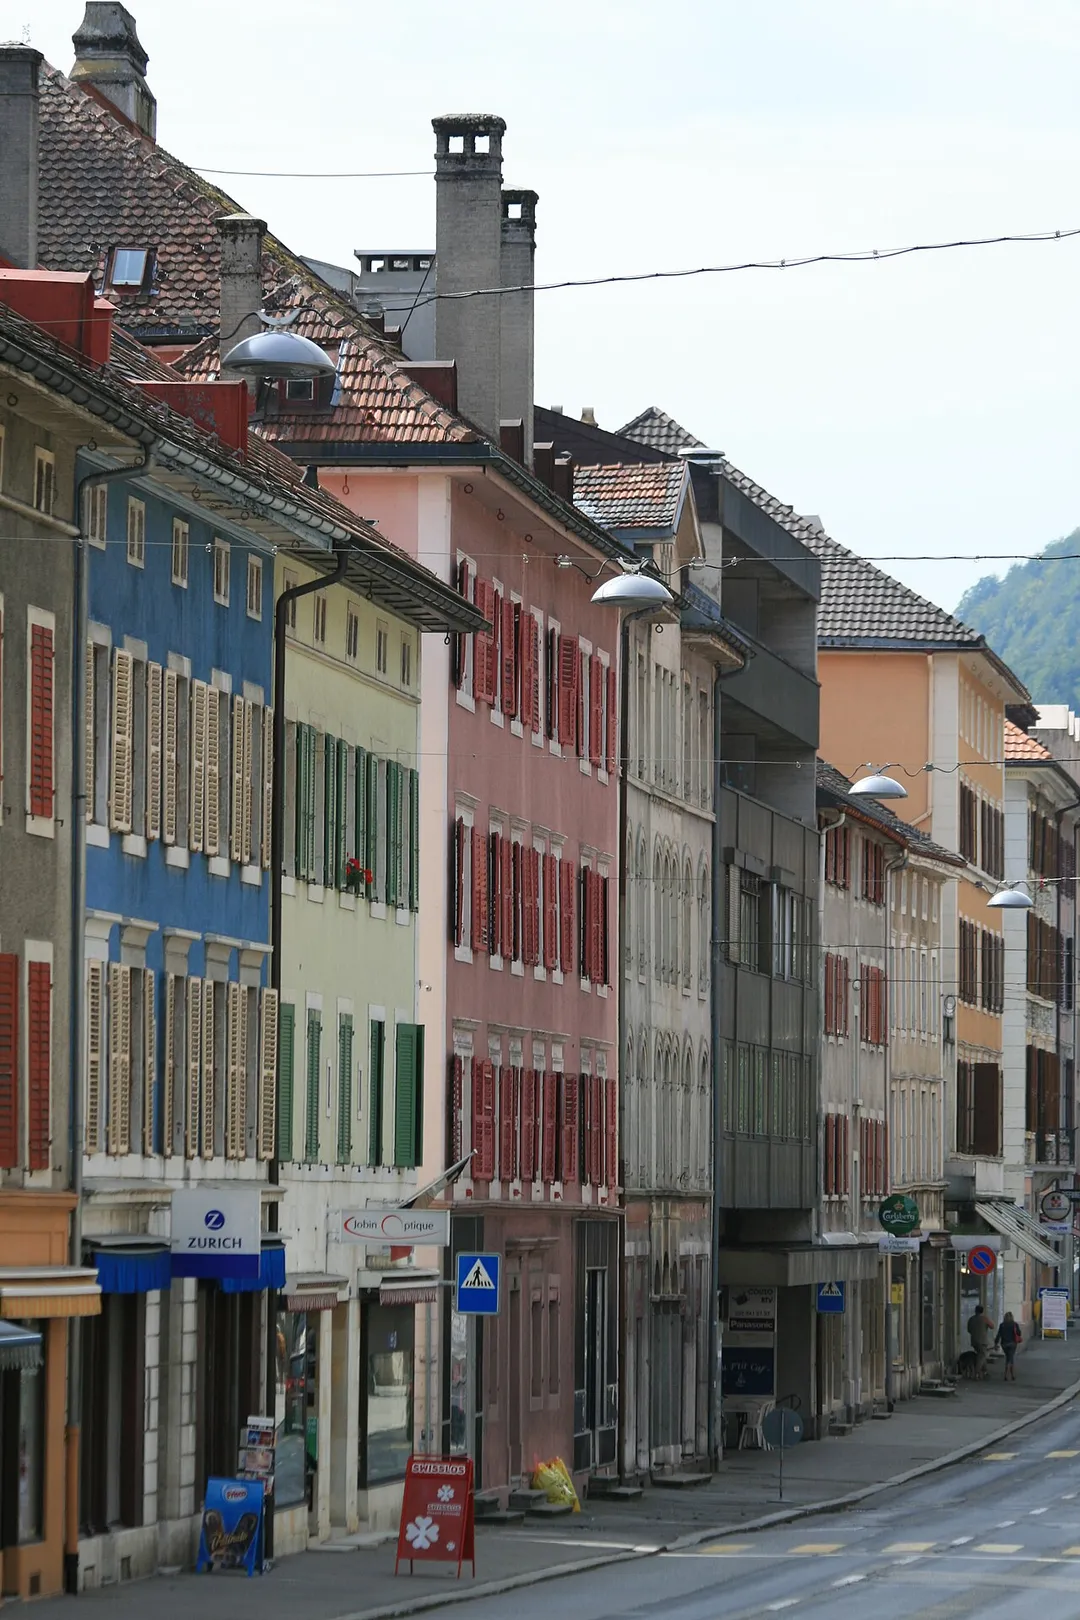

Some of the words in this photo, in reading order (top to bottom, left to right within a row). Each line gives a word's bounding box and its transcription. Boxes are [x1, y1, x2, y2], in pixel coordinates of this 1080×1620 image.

[882, 1210, 915, 1222] Carlsberg
[353, 1219, 377, 1230] Jobin
[381, 1215, 434, 1237] Optique
[187, 1237, 242, 1249] ZURICH
[730, 1320, 773, 1329] Panasonic
[411, 1463, 466, 1476] SWISSLOS
